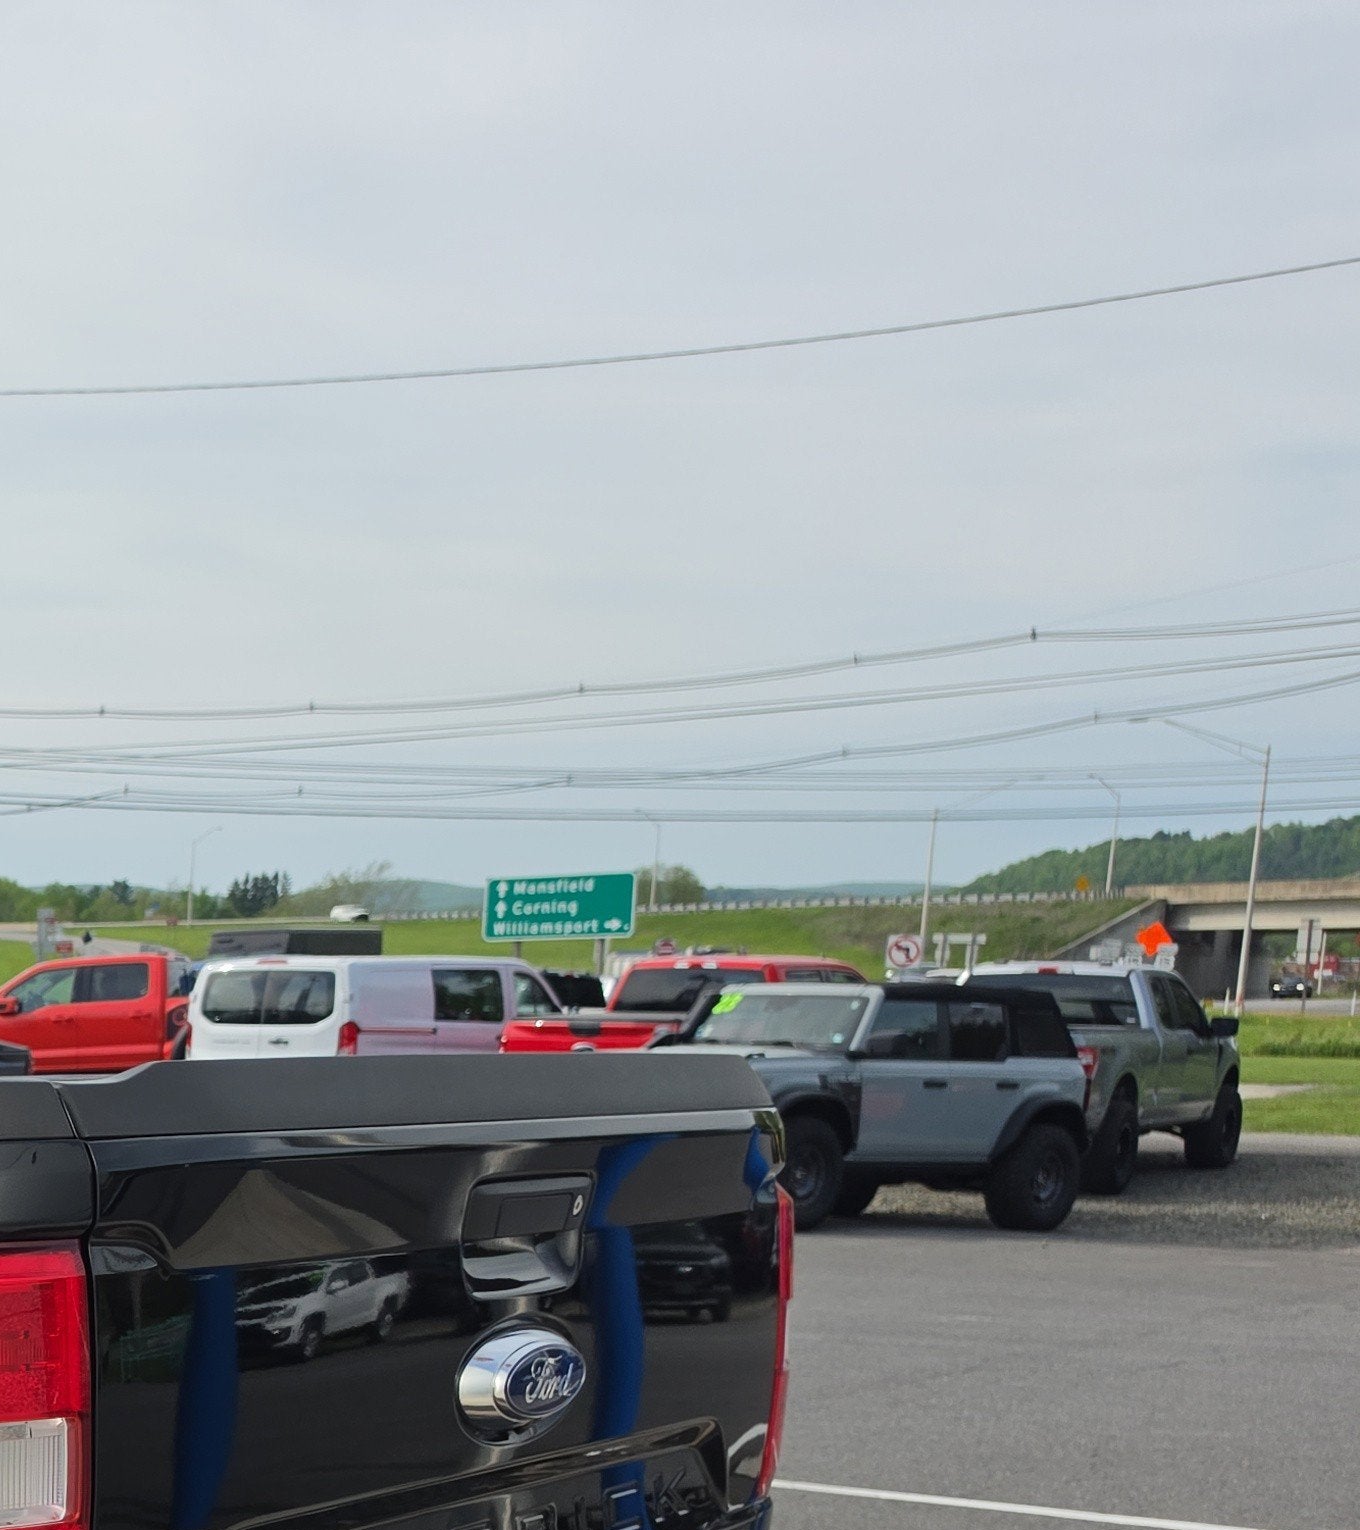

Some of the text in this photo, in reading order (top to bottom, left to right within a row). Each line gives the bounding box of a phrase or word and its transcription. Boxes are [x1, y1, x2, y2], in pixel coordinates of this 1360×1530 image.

[513, 876, 596, 896] Mansfield
[512, 898, 579, 917] Corning
[493, 918, 600, 936] Williamsport
[524, 1354, 578, 1404] Ford
